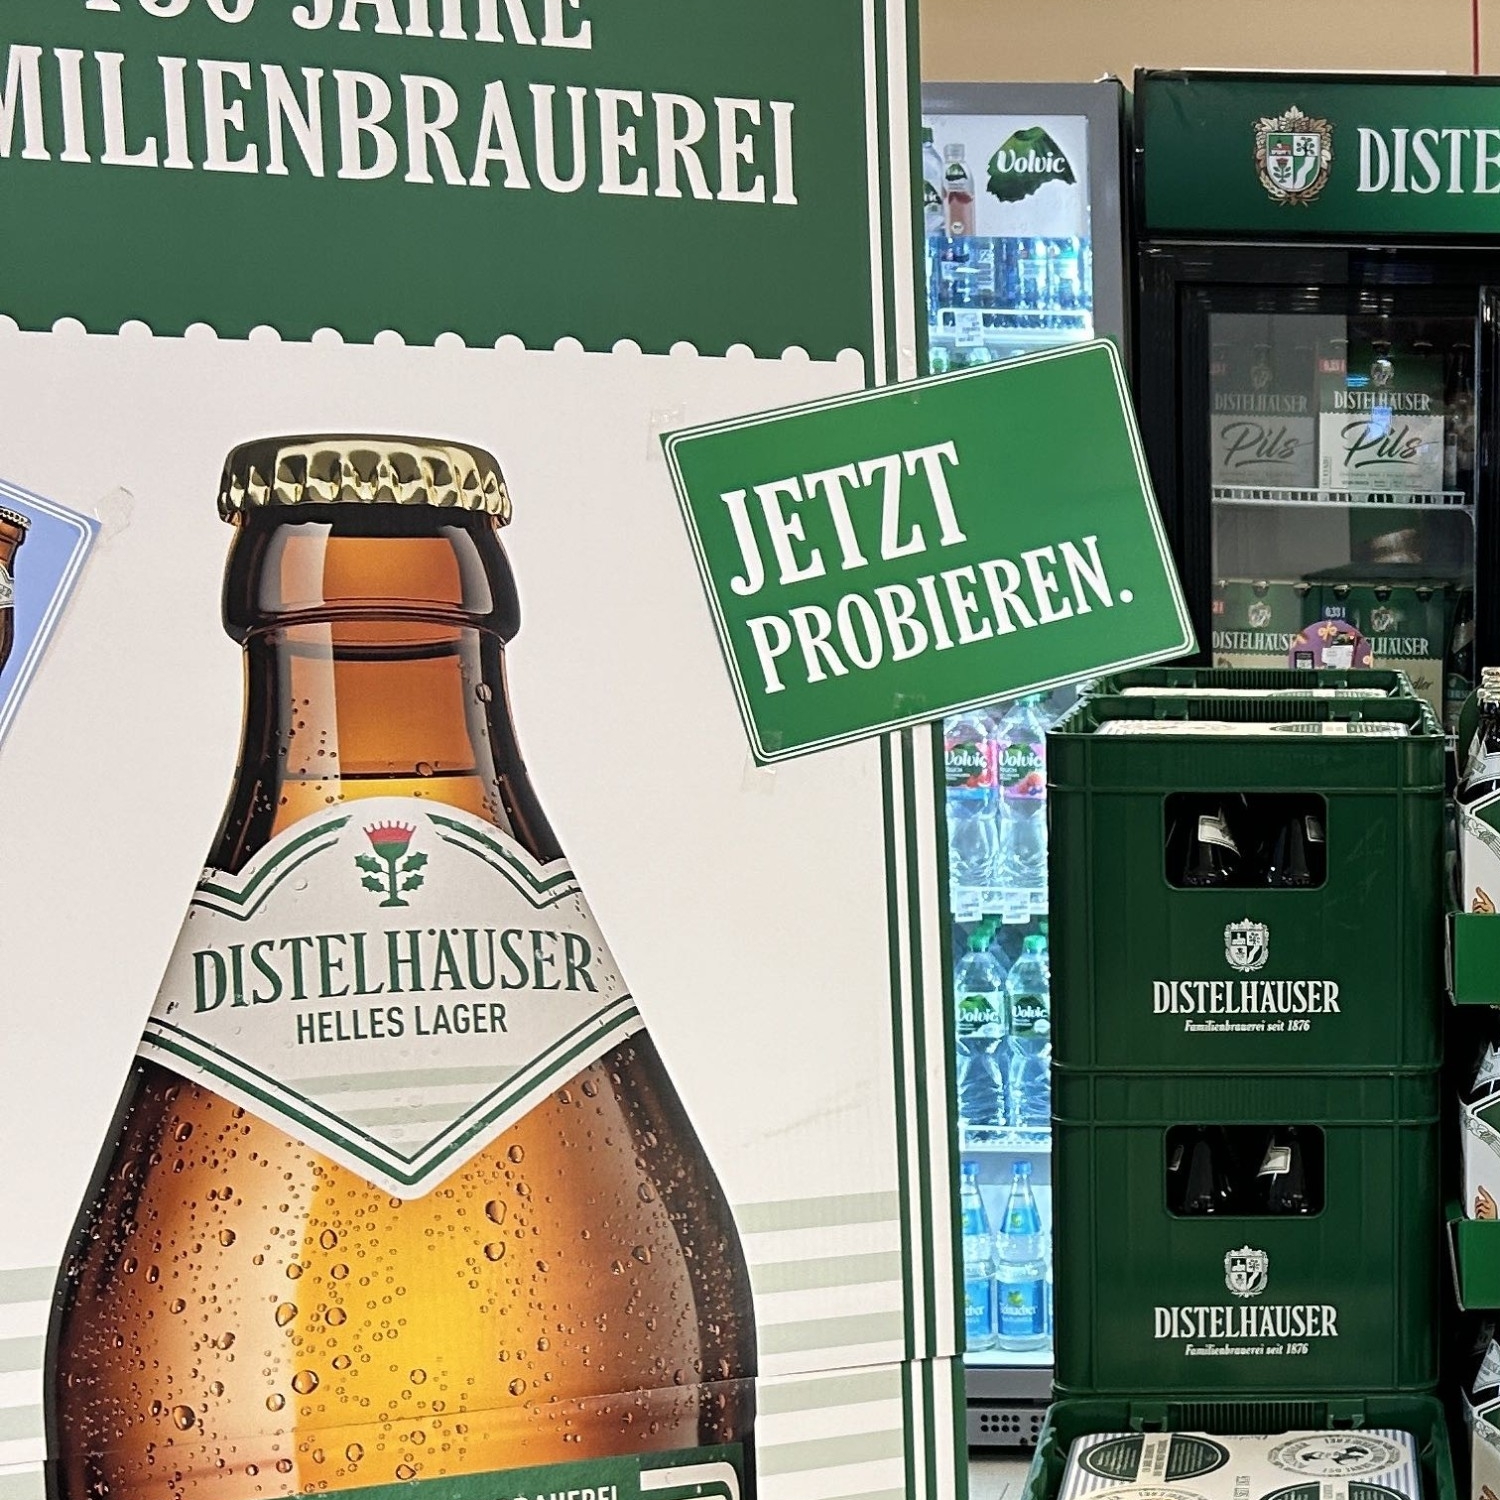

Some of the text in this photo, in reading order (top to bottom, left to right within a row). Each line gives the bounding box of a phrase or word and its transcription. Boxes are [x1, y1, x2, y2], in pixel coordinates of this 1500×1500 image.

[997, 150, 1067, 174] Volvic
[1220, 421, 1314, 468] Pils
[1340, 421, 1440, 468] Pils
[720, 440, 967, 597] JETZT
[746, 535, 1135, 695] PROBIEREN.
[945, 750, 986, 768] Volvic
[999, 750, 1044, 768] Volvic
[192, 928, 599, 1014] DISTELHÄUSER
[1153, 980, 1342, 1014] DISTELHÄUSER
[296, 1003, 508, 1045] HELLES LAGER
[1184, 1019, 1311, 1032] Familienbrauerei seit 1876
[1154, 1305, 1338, 1338] DISTELHÄUSER
[1185, 1343, 1309, 1355] Familienbrauerei seit 1876
